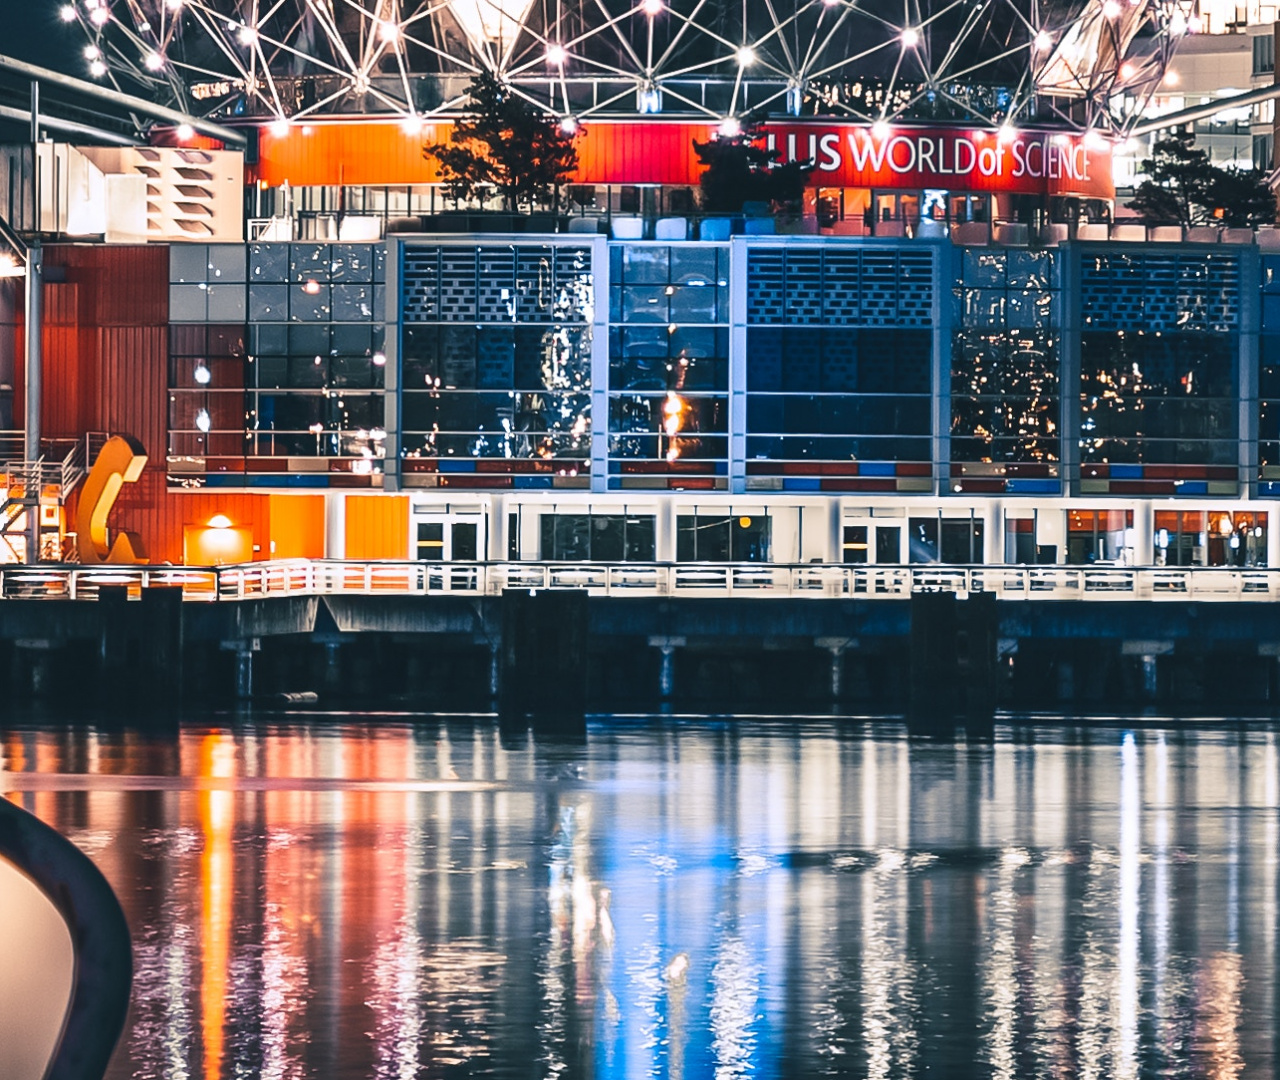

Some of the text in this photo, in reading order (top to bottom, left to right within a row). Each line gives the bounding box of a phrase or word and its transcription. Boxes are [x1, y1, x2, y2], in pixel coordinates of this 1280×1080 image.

[743, 131, 1091, 181] LUS WORLD of SCIENCE
